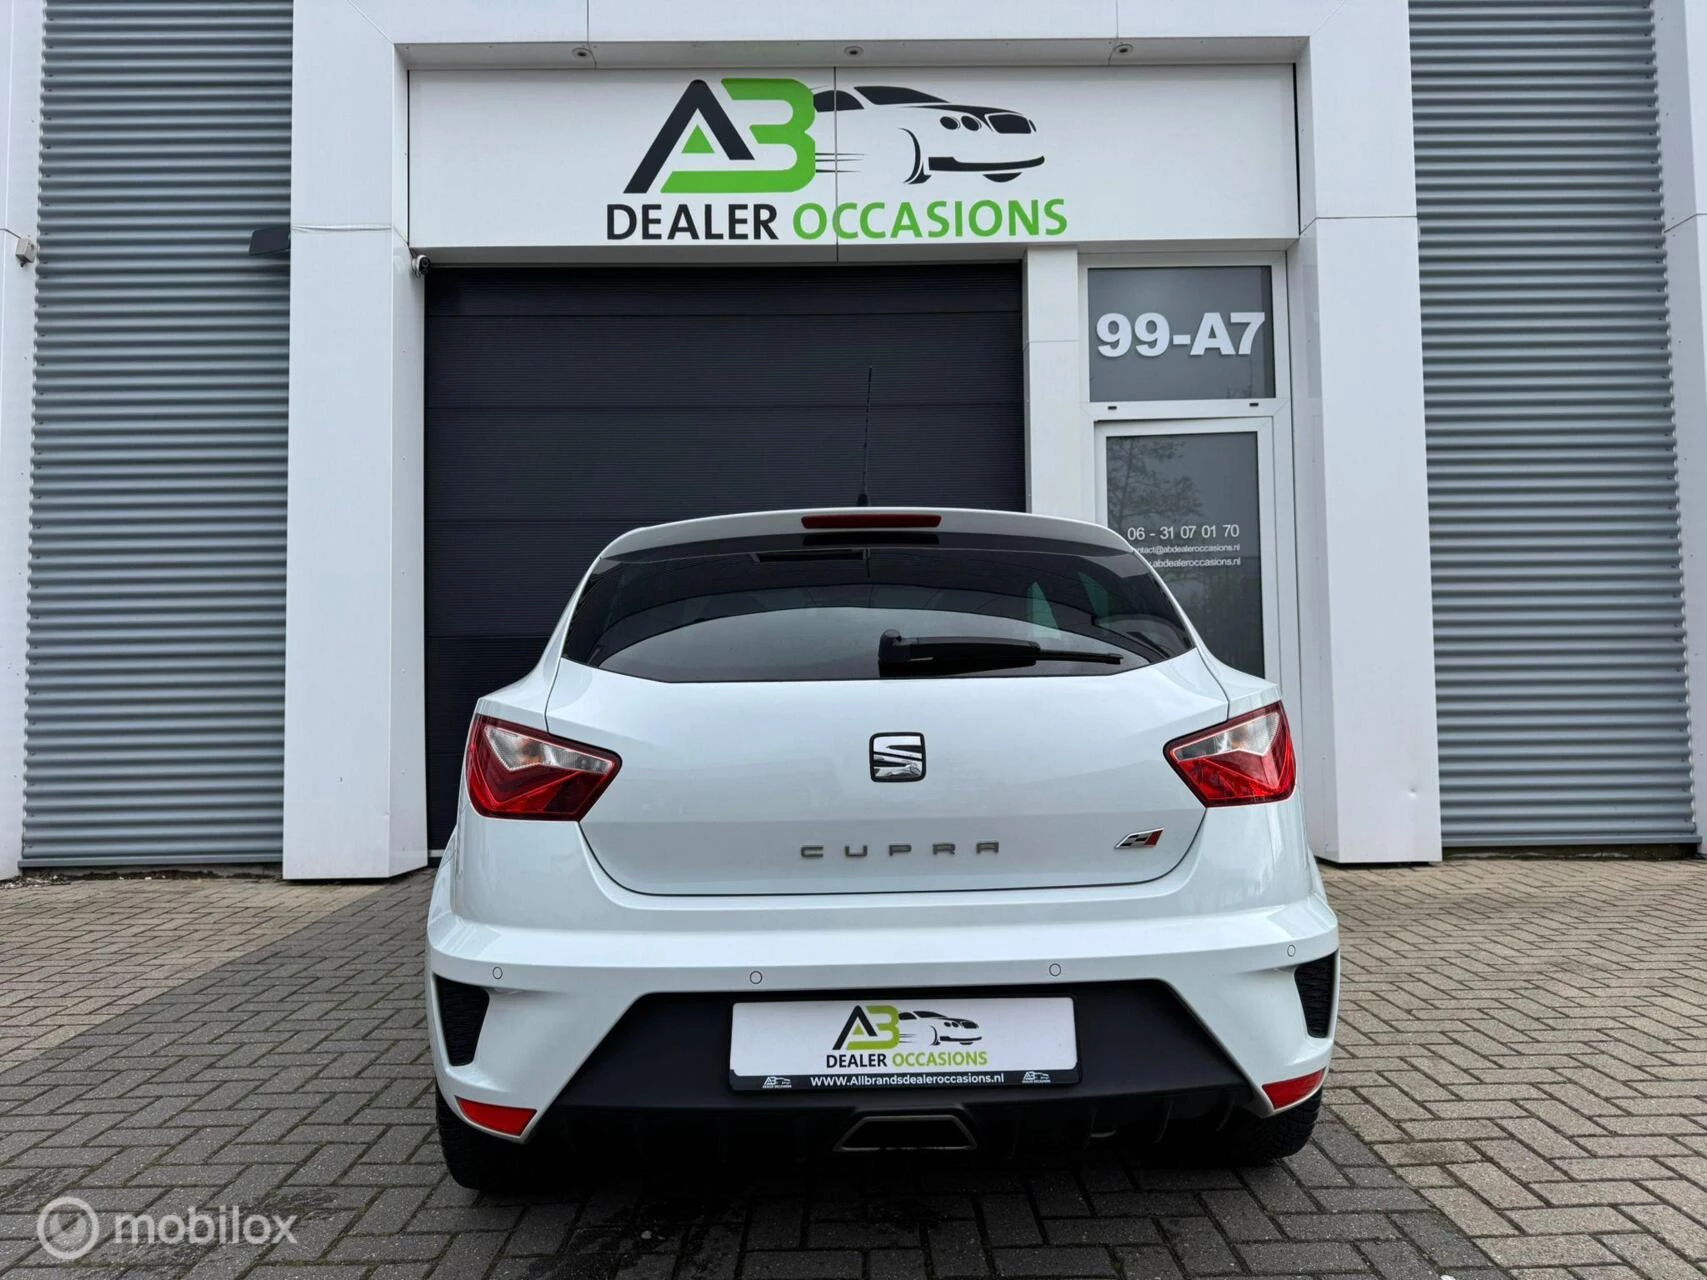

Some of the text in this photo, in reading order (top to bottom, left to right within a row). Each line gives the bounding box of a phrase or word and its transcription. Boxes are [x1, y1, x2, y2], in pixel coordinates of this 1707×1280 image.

[606, 198, 1068, 240] DEALER OCCASIONS
[1096, 312, 1266, 357] 99-A7
[1127, 527, 1145, 540] 06
[1160, 526, 1174, 540] 31
[1180, 525, 1197, 539] 07
[1201, 524, 1216, 538] 01
[1222, 524, 1240, 537] 70
[1135, 543, 1240, 555] ntact@abdealeroccasions.nl
[1149, 557, 1241, 568] .abdealeroccasions.nl
[800, 841, 1000, 858] CUPRA
[826, 1051, 988, 1069] DEALER OCCASIONS
[810, 1073, 1005, 1087] WWW.Allbrandsdealeroccasions.nl
